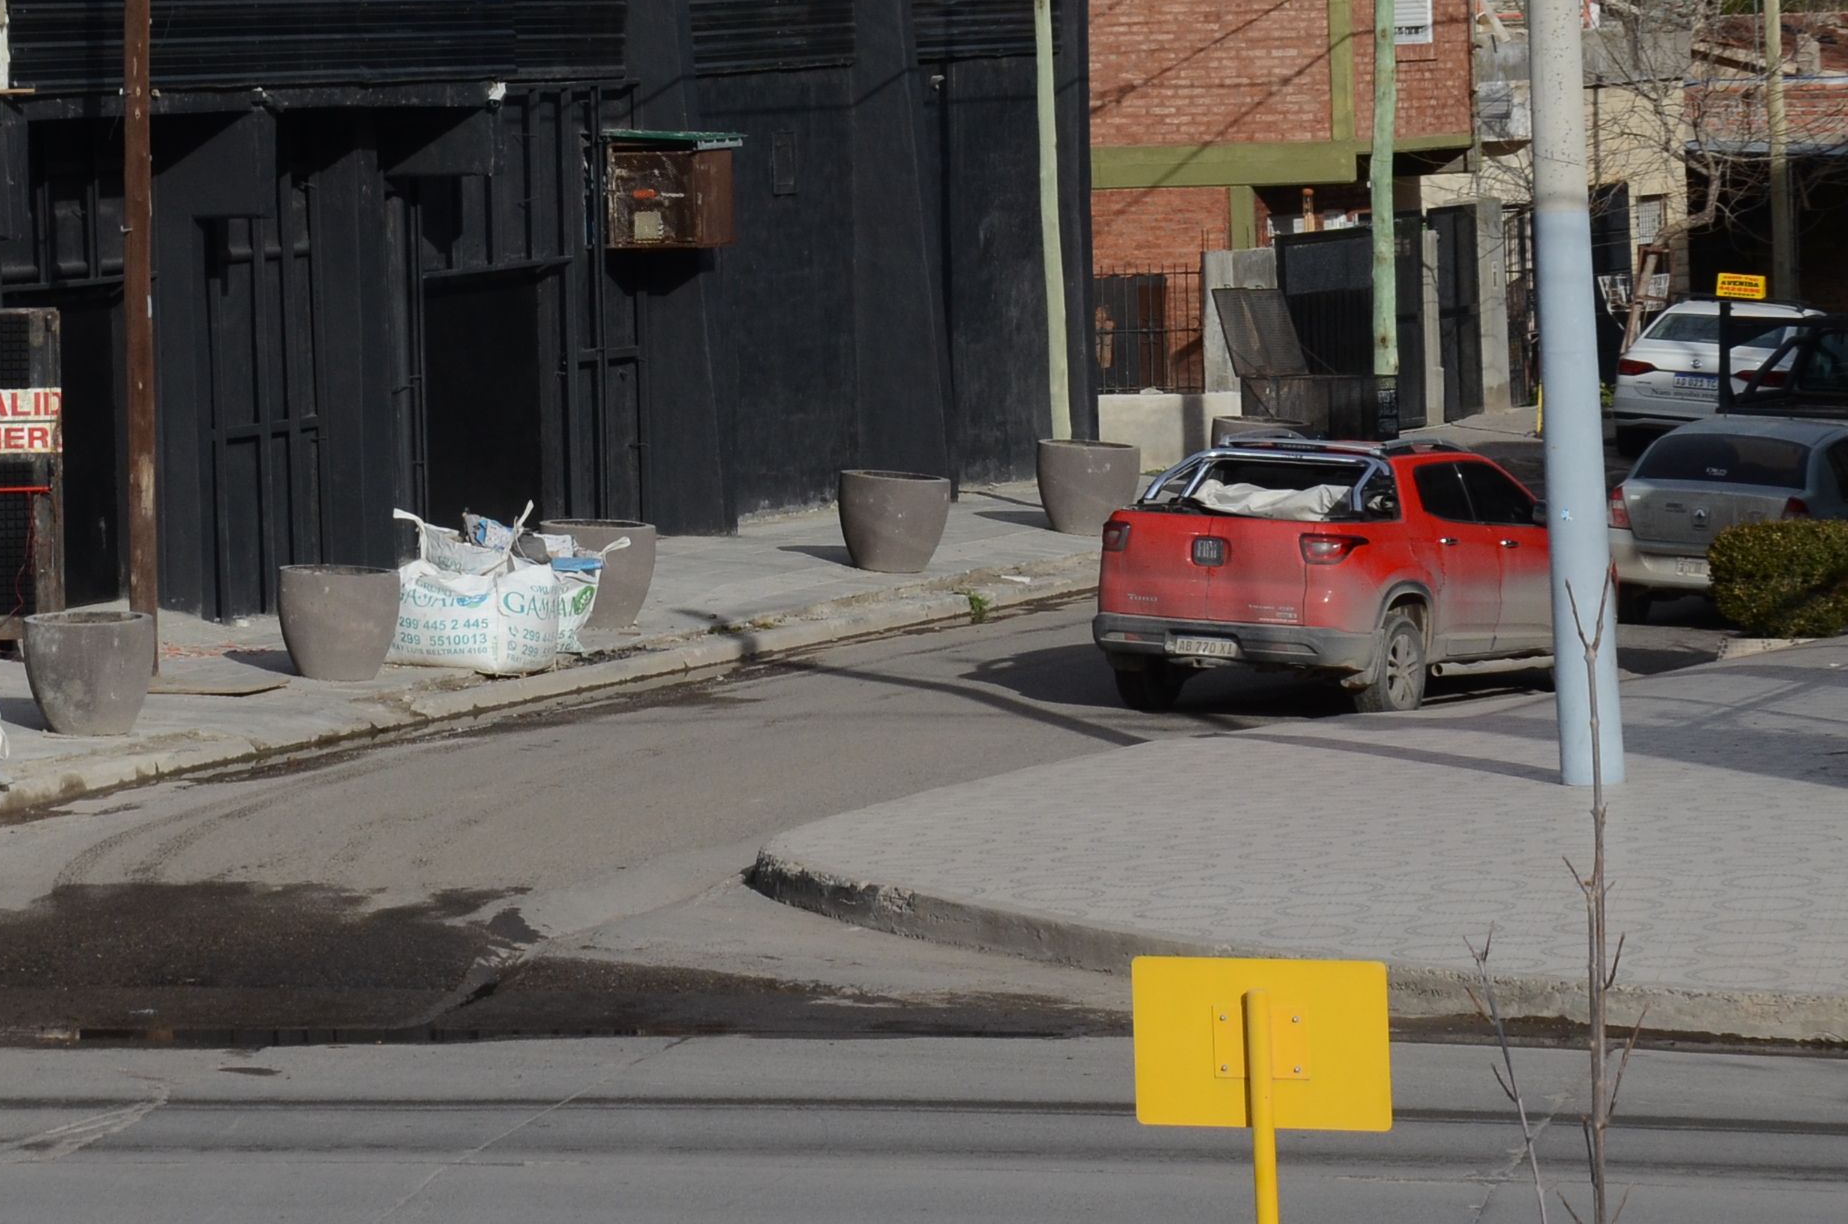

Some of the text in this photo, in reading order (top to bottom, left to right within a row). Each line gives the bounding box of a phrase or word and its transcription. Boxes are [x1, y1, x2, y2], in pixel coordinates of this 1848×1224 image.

[1721, 280, 1759, 288] AVENIDA
[399, 616, 489, 631] 299 445 2 445
[400, 632, 487, 647] 299 5510013
[523, 628, 541, 643] 299
[426, 647, 465, 656] BELTRAN
[522, 644, 539, 657] 299
